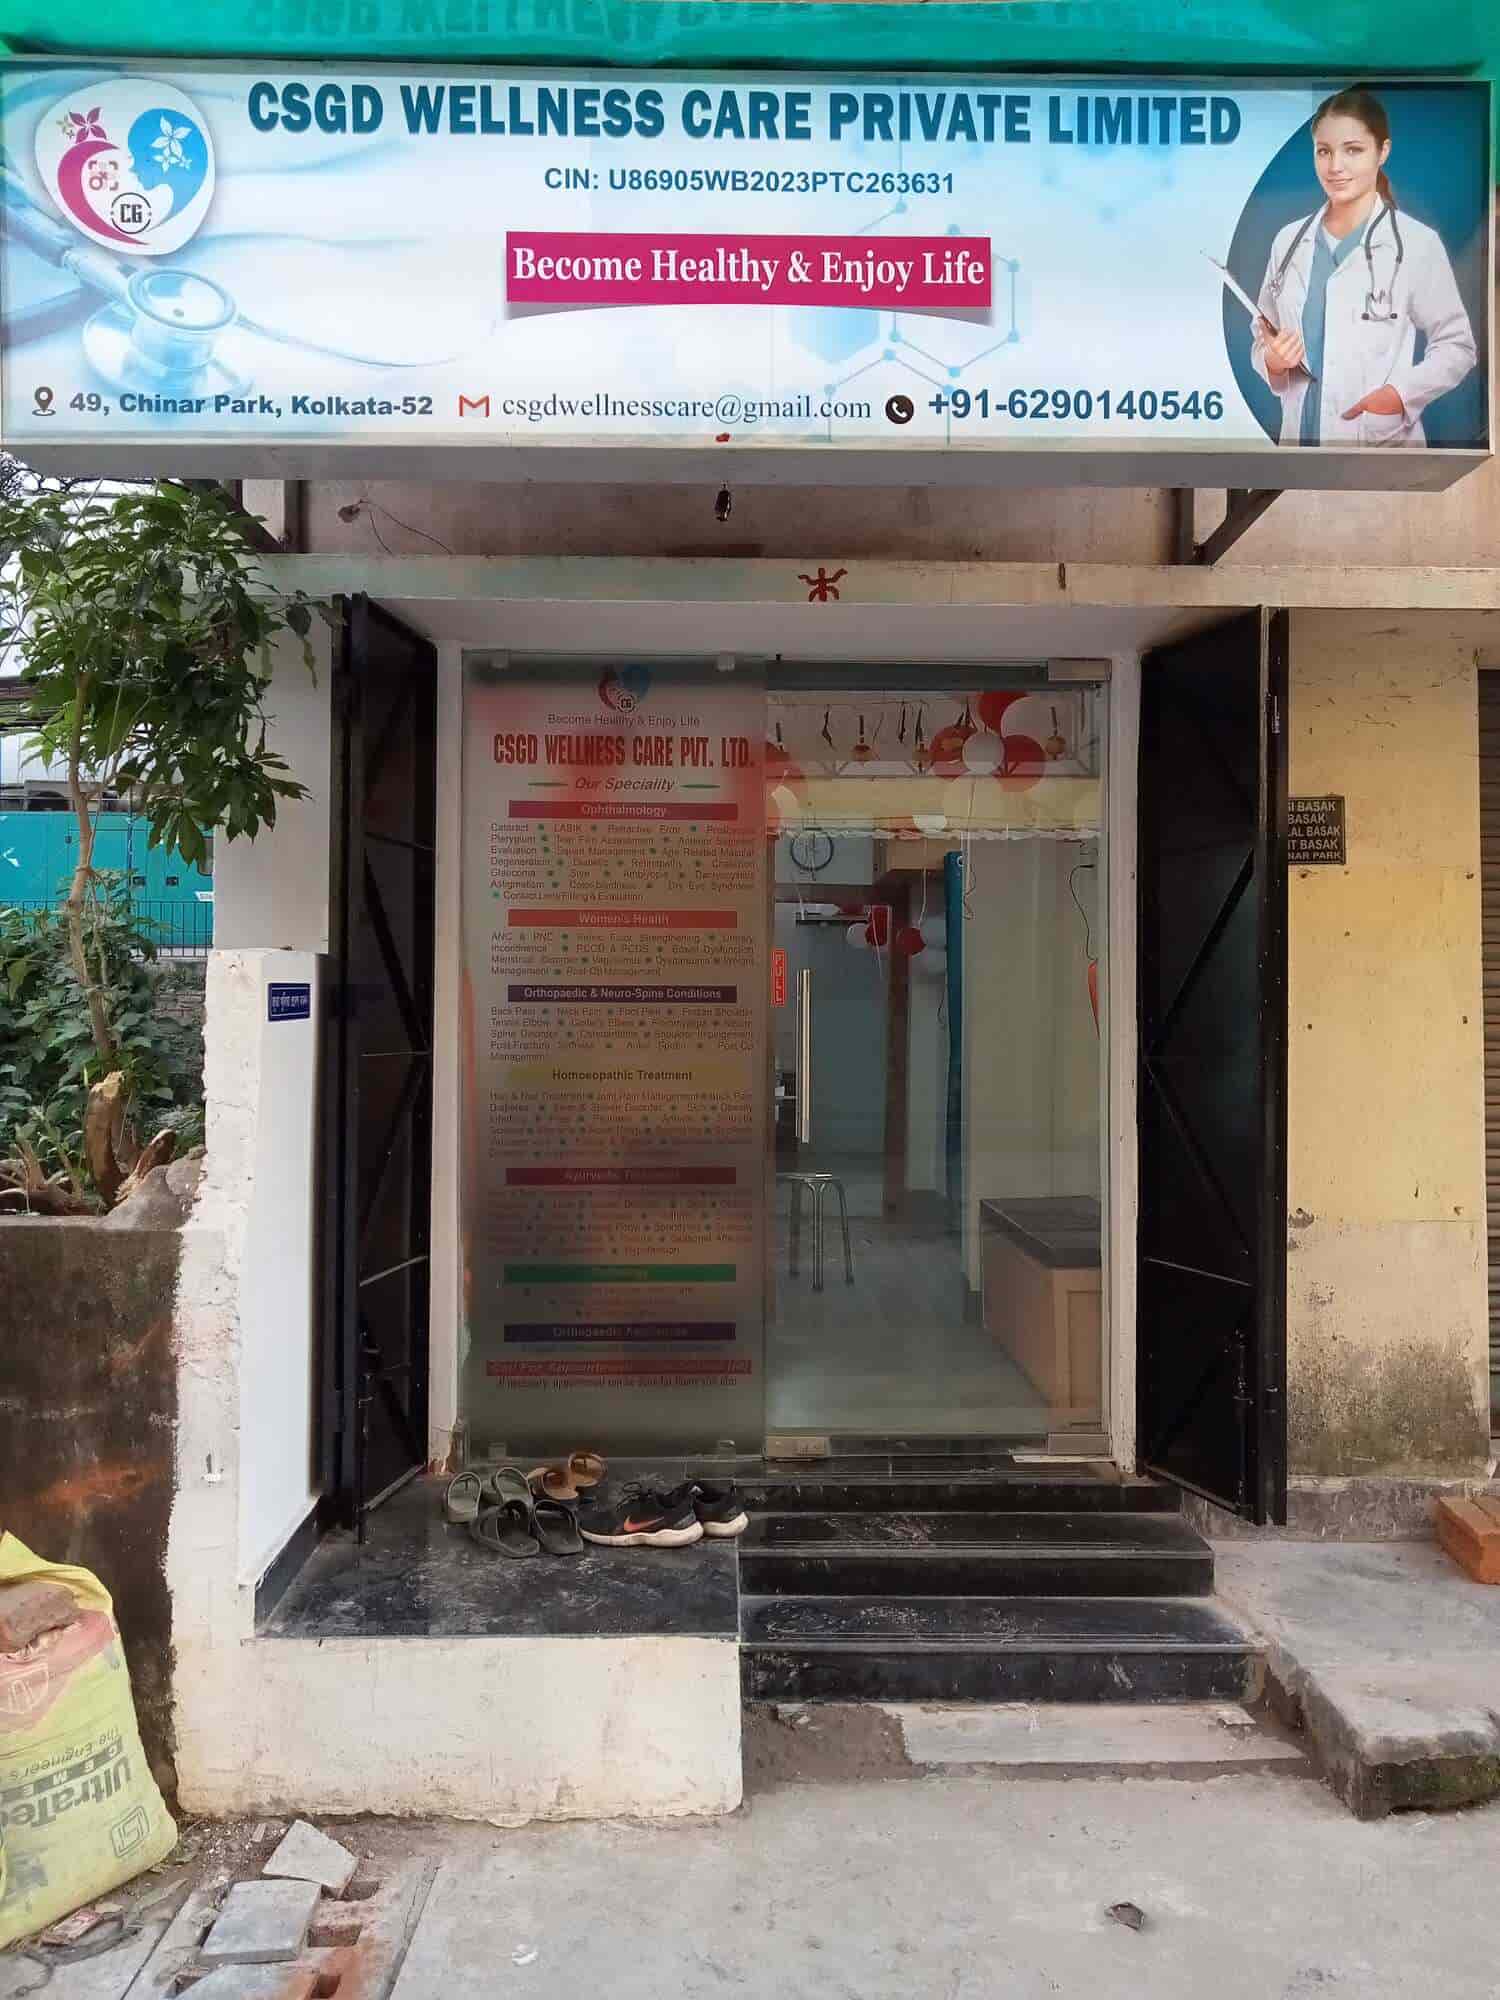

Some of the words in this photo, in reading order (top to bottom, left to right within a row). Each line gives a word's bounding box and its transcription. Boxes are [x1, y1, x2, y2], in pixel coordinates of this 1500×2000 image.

[247, 82, 384, 134] CSGD
[400, 85, 665, 138] WELLNESS
[681, 89, 812, 140] CARE
[829, 92, 1031, 143] PRIVATE
[1049, 95, 1242, 146] LIMITED
[544, 167, 600, 190] CIN:
[608, 168, 955, 195] U86905WB2023PTC263631
[513, 246, 641, 283] Become
[651, 249, 778, 292] Healthy
[786, 252, 813, 283] &
[821, 250, 913, 293] Enjoy
[921, 250, 986, 286] Life
[69, 391, 110, 418] 49,
[119, 391, 206, 416] Chinar
[214, 393, 282, 418] Park,
[291, 393, 433, 417] Kolkata-52
[502, 393, 871, 423] csgdwellnesscare@gmail.com
[927, 390, 1224, 421] +91-6290140546
[494, 734, 538, 764] CSGD
[545, 735, 626, 766] WELLNESS
[633, 737, 673, 768] CARE
[680, 738, 714, 768] PVT.
[721, 738, 755, 768] LTD.
[575, 777, 600, 791] Our
[605, 777, 675, 793] Speciality
[1297, 801, 1336, 811] BASAK
[1300, 839, 1338, 850] BASAK
[1306, 826, 1340, 837] BASAK
[552, 1069, 633, 1083] Homoeopathic
[638, 1070, 692, 1081] Treatment
